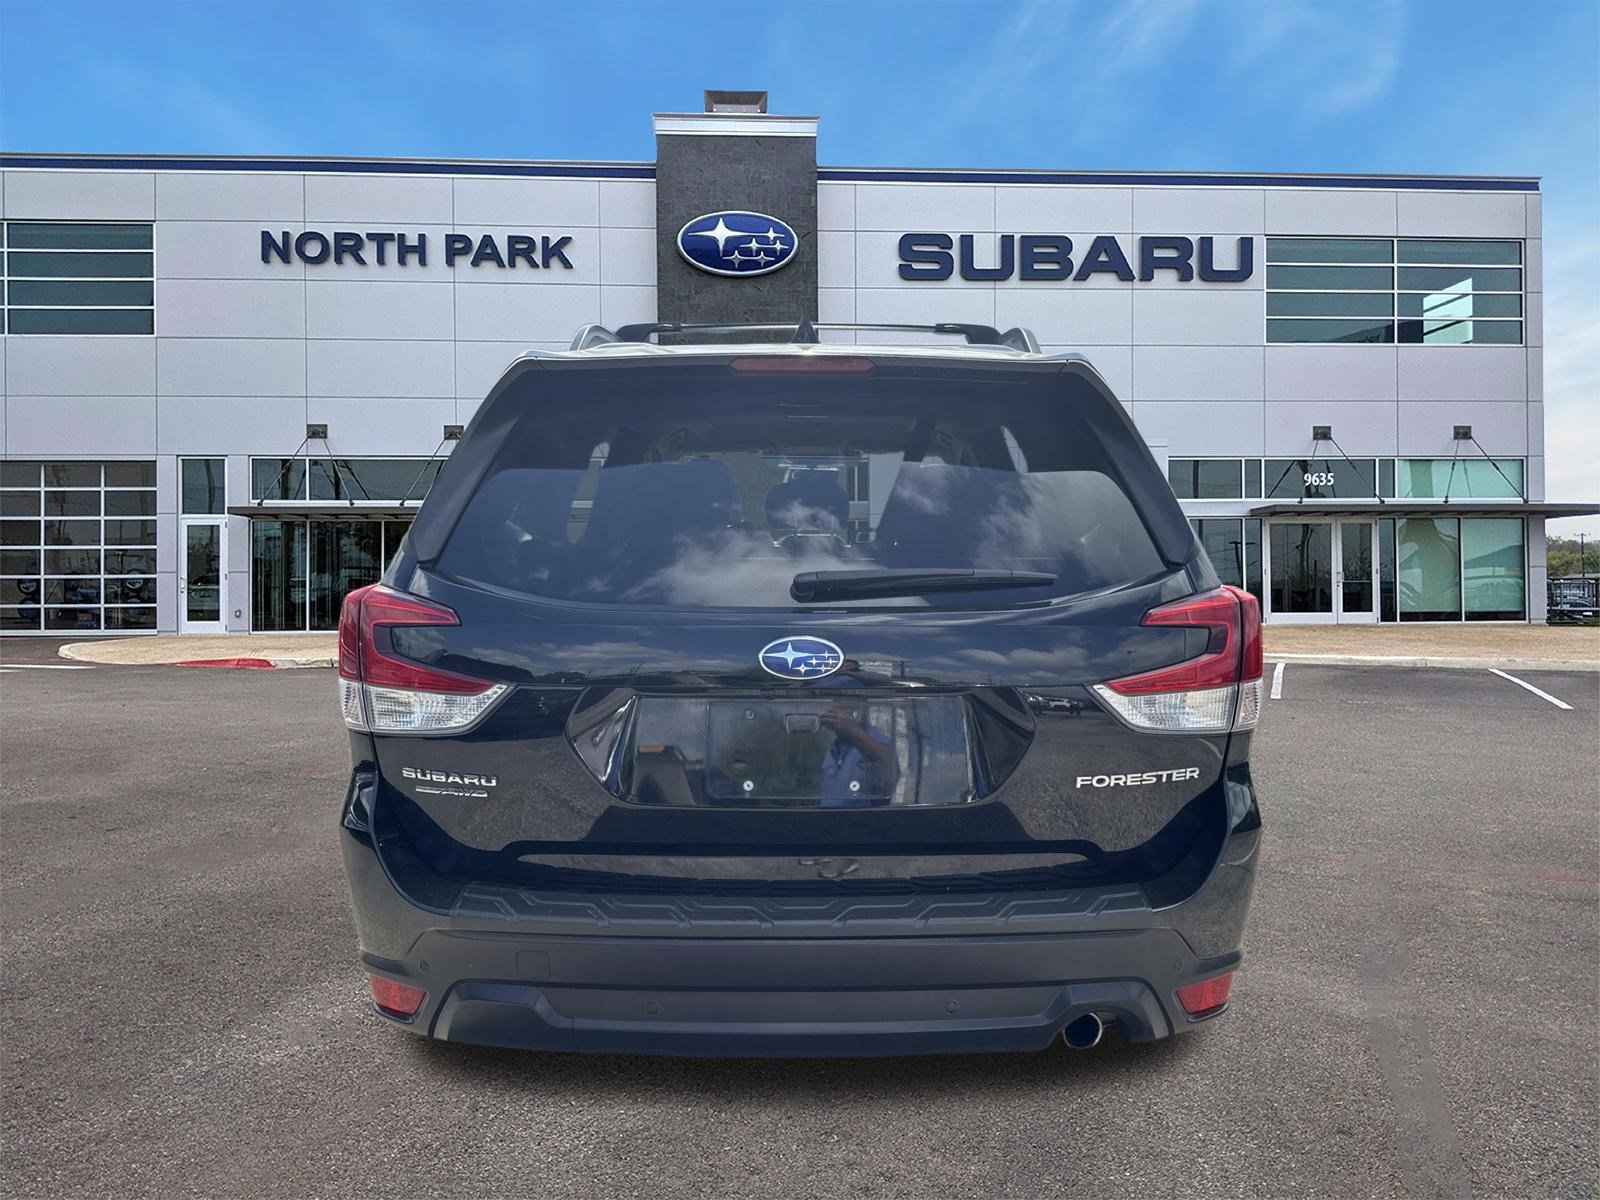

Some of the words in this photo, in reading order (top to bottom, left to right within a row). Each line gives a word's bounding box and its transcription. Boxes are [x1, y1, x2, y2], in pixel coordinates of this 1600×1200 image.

[261, 230, 427, 266] NORTH
[445, 233, 574, 269] PARK
[898, 233, 1254, 282] SUBARU
[1303, 472, 1334, 486] 9635
[402, 767, 497, 786] SUBARU
[1076, 767, 1200, 788] FORESTER
